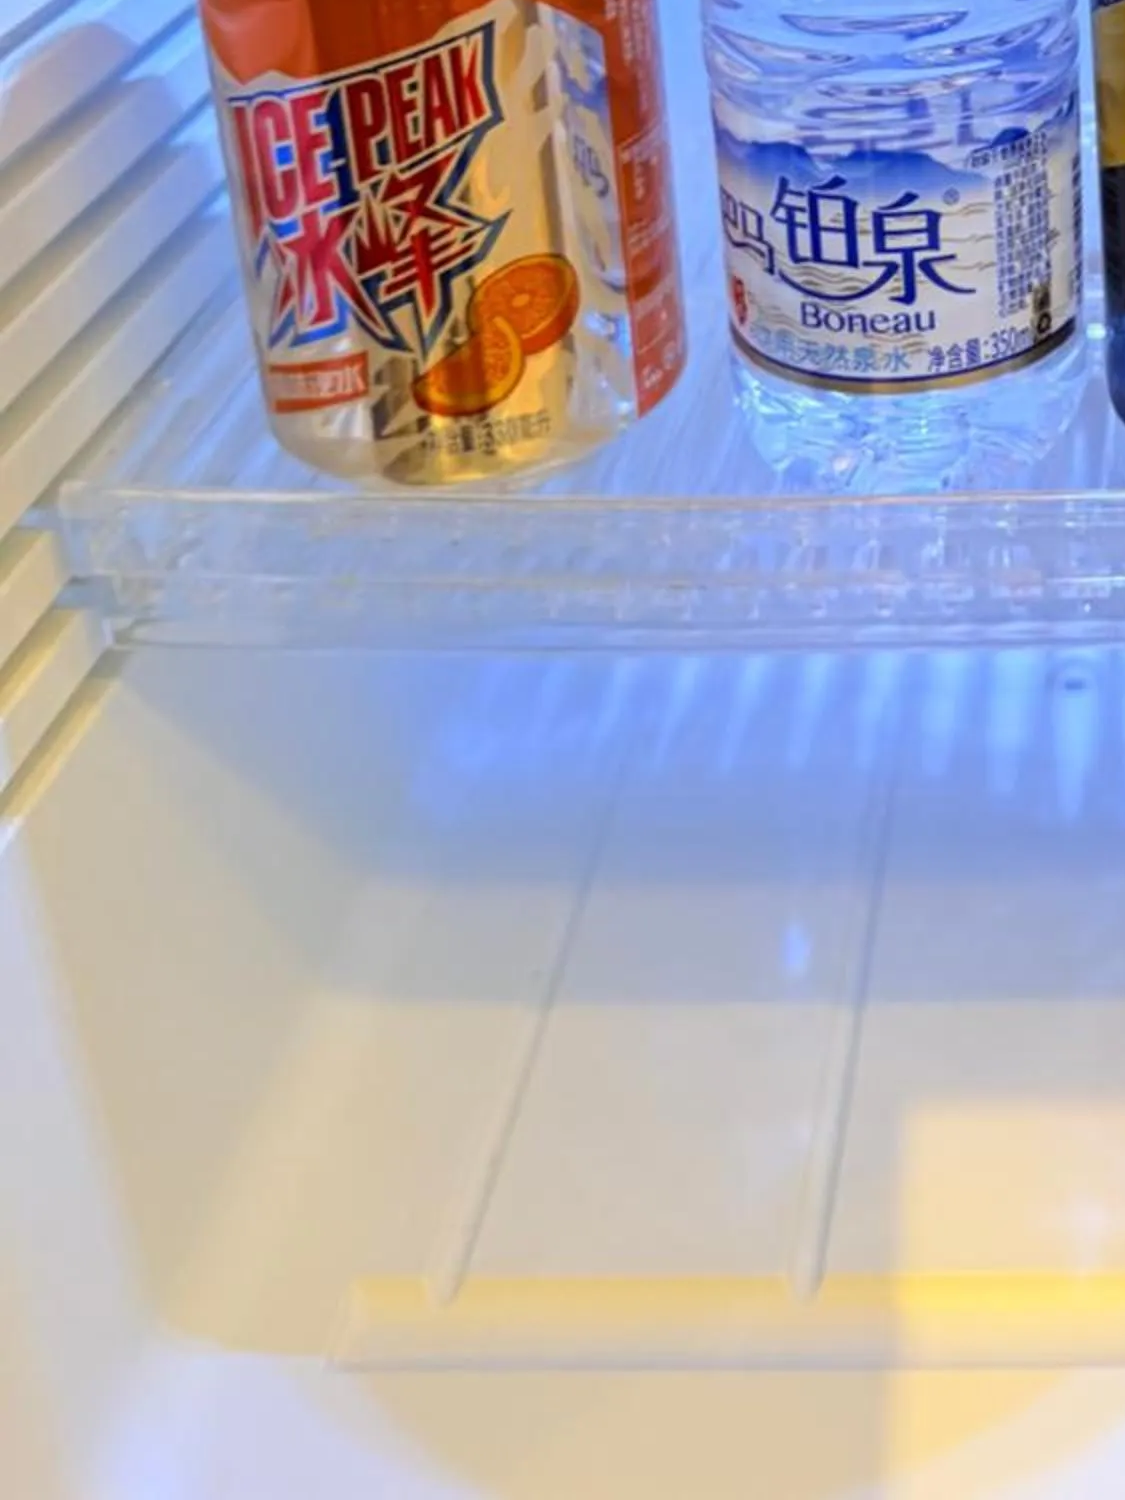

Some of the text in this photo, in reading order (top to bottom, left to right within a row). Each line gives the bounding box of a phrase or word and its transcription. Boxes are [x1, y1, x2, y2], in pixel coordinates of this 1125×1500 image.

[231, 88, 339, 245] ICE
[343, 38, 487, 188] PEAK
[262, 145, 482, 340] 冰峰
[800, 300, 937, 335] Boneau
